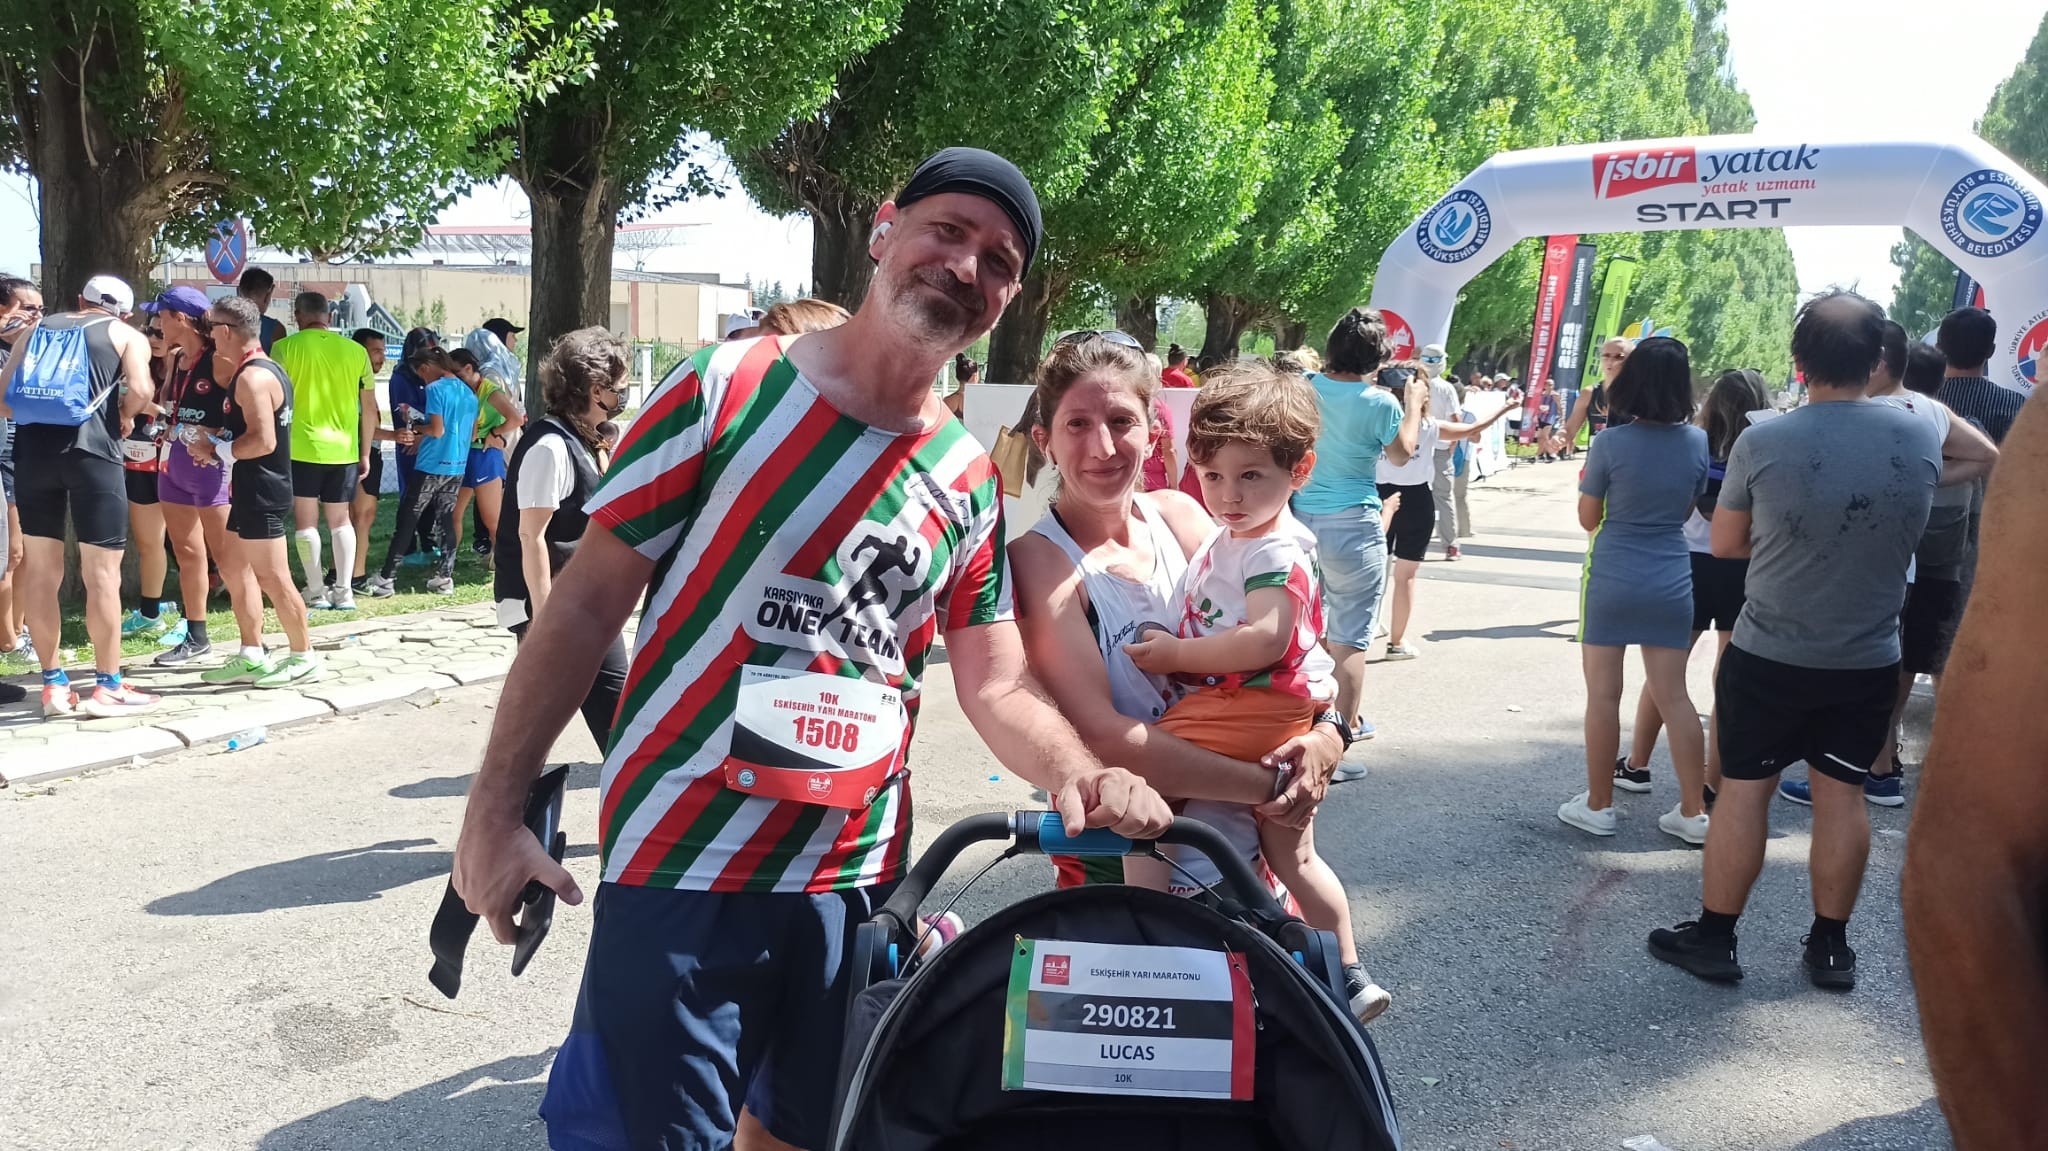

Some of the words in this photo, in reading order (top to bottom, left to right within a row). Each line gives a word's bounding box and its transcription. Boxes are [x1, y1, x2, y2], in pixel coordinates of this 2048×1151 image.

[1701, 143, 1820, 182] yatak
[1702, 179, 1748, 197] yatak
[1756, 178, 1816, 192] uzmanı
[1636, 197, 1791, 223] START
[1943, 177, 1976, 247] BÜYÜKŞEHİR
[1966, 222, 2035, 256] BELEDİYESİ
[1419, 237, 1478, 262] BÜYÜKŞEHİR
[1466, 194, 1490, 245] BELEDİYESİ
[16, 386, 65, 398] LATITUDE
[763, 586, 824, 610] KARŞIYAKA
[757, 601, 821, 636] ONE
[773, 698, 815, 713] ESKİŞEHİR
[817, 705, 836, 716] YARI
[837, 708, 877, 724] MARATONU
[818, 691, 840, 706] 10K
[792, 715, 860, 753] 1508
[1090, 967, 1131, 979] ESKİŞEHİR
[1132, 971, 1151, 980] YARI
[1152, 971, 1201, 981] MARATONU
[1081, 1003, 1176, 1030] 290821
[1100, 1043, 1155, 1061] LUCAS
[1114, 1073, 1133, 1084] 10K
